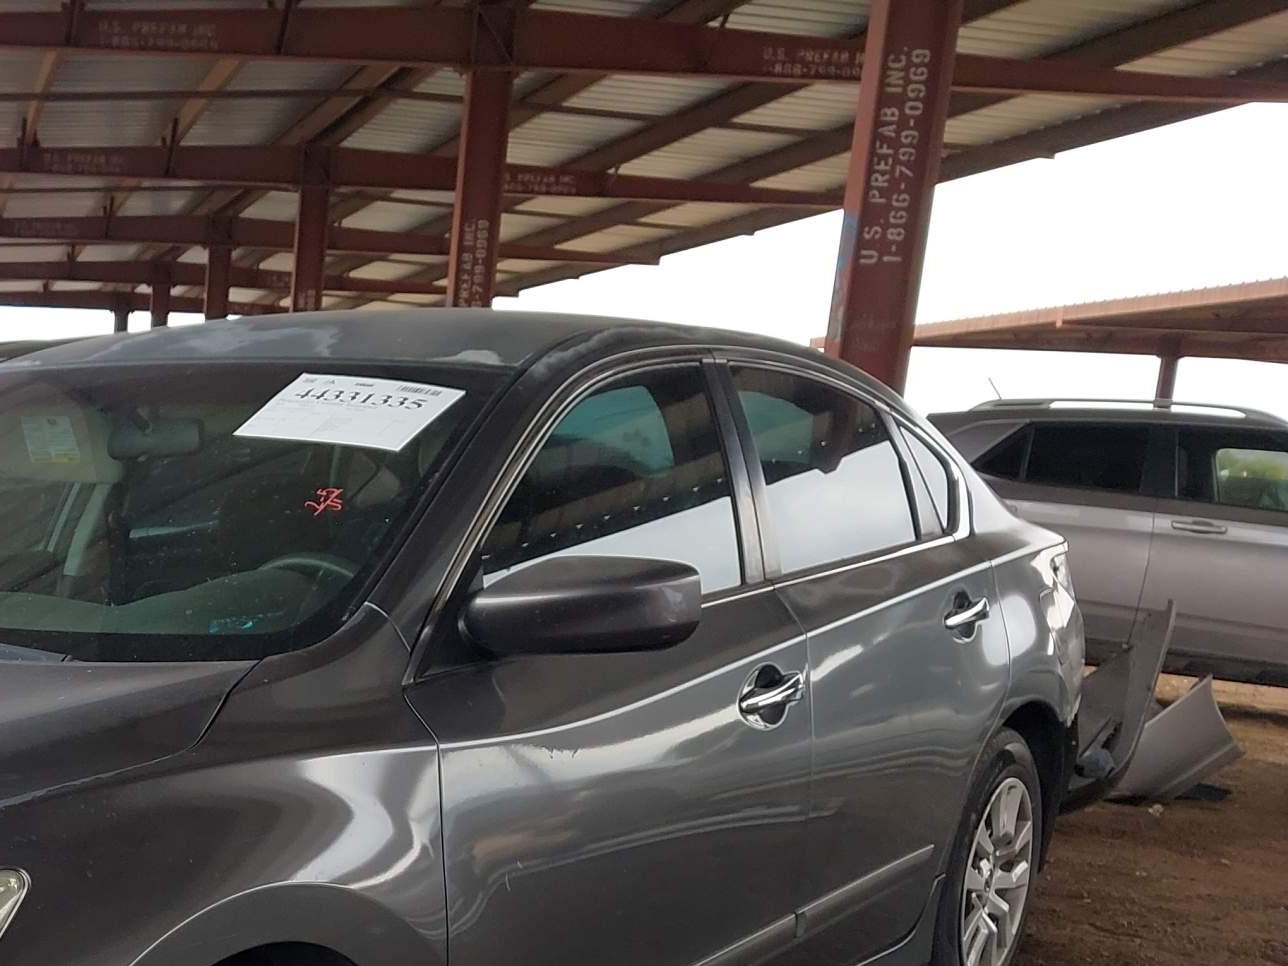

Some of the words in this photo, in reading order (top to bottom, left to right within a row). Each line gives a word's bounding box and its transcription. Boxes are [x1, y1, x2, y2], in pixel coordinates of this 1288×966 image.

[885, 46, 908, 94] INC.
[869, 106, 900, 203] PREFAB
[882, 48, 931, 263] 1-866-799-0969
[859, 218, 885, 265] U.S.
[295, 387, 429, 411] 44331335
